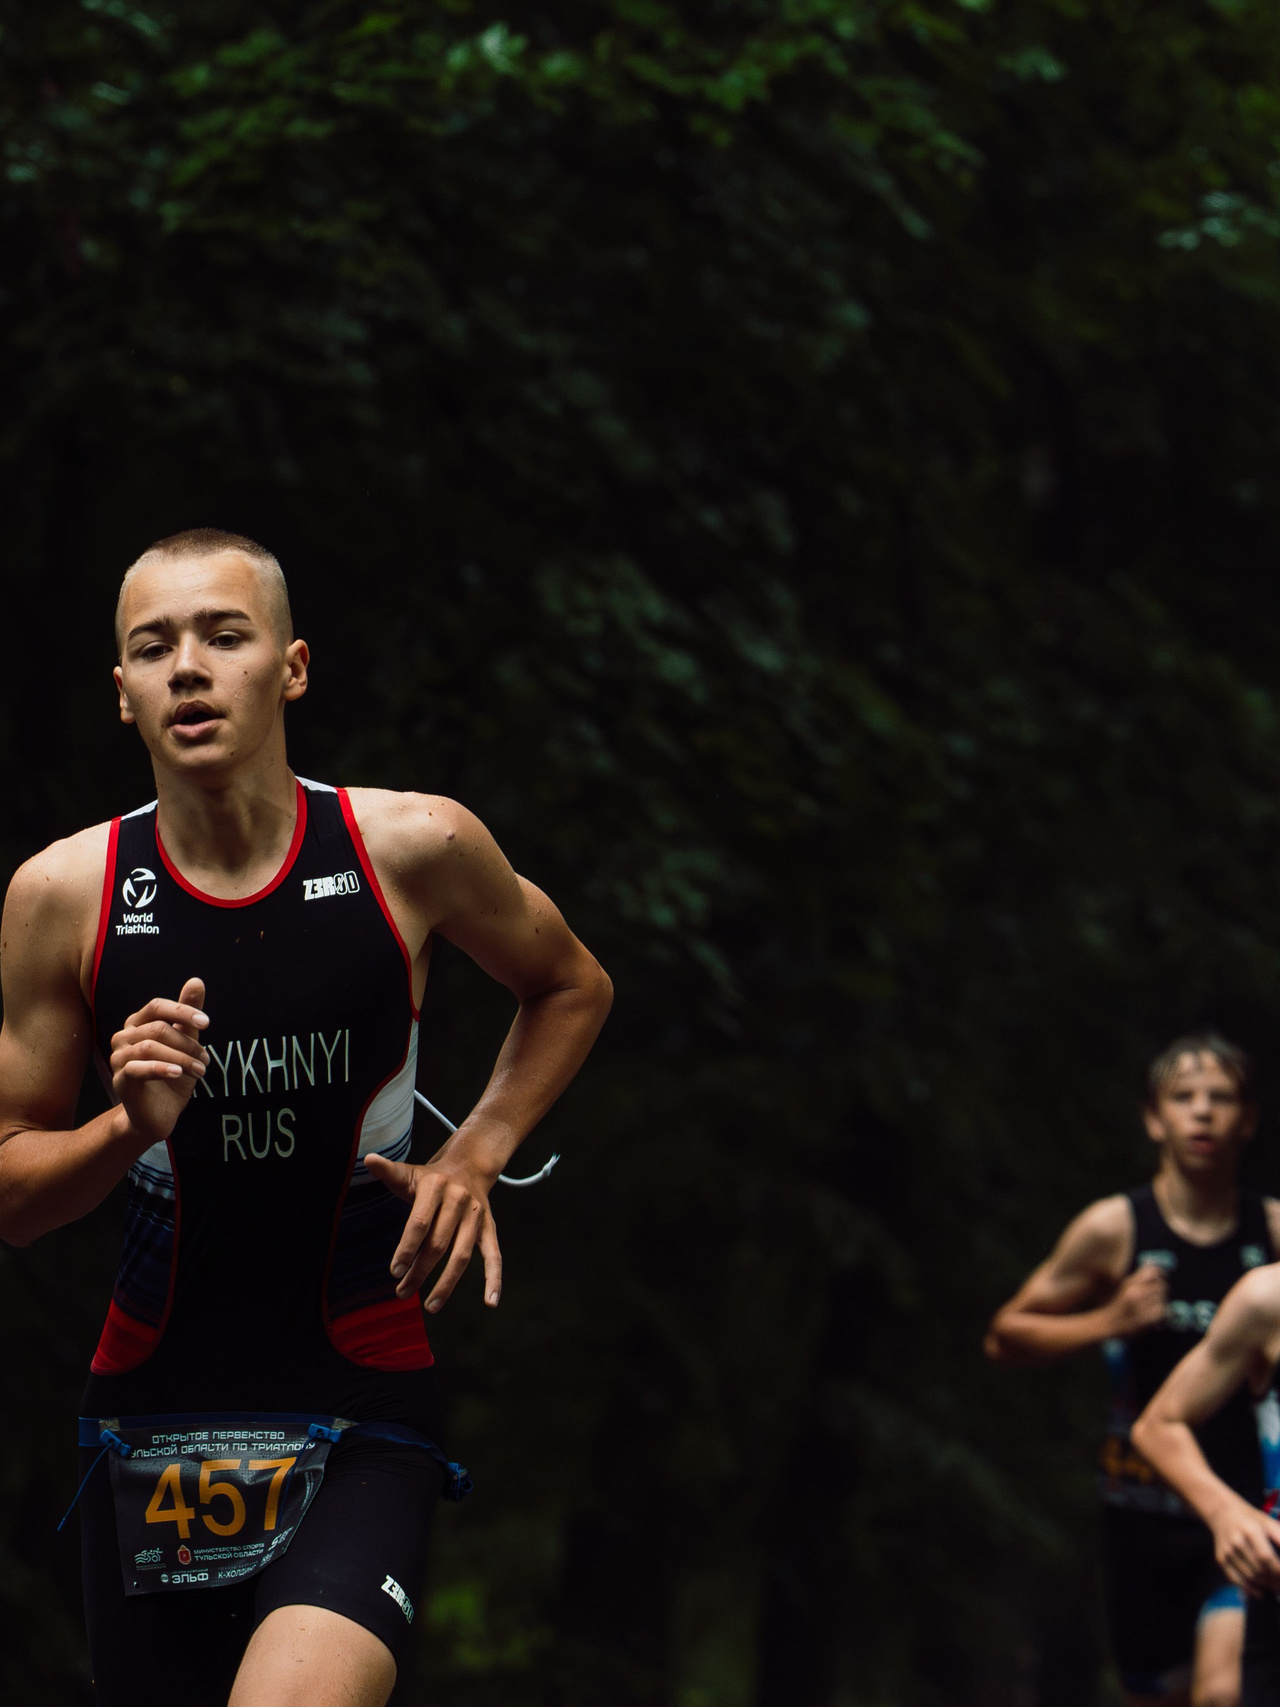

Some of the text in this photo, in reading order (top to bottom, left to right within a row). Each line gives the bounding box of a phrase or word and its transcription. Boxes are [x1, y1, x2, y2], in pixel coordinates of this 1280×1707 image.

[123, 912, 153, 924] World
[115, 923, 160, 936] Triathlon
[221, 1107, 296, 1162] RUS
[152, 1431, 285, 1444] ОТКРЫТОЕ ПЕРВЕНСТВО
[131, 1443, 178, 1459] УЛЬСКОЙ
[181, 1443, 229, 1454] ОБЛАСТИ
[232, 1443, 248, 1451] ПО
[145, 1456, 298, 1540] 457
[194, 1548, 264, 1561] ТУЛЬСКОЙ ОБЛАСТИ
[171, 1572, 209, 1584] ЭЛЬФ
